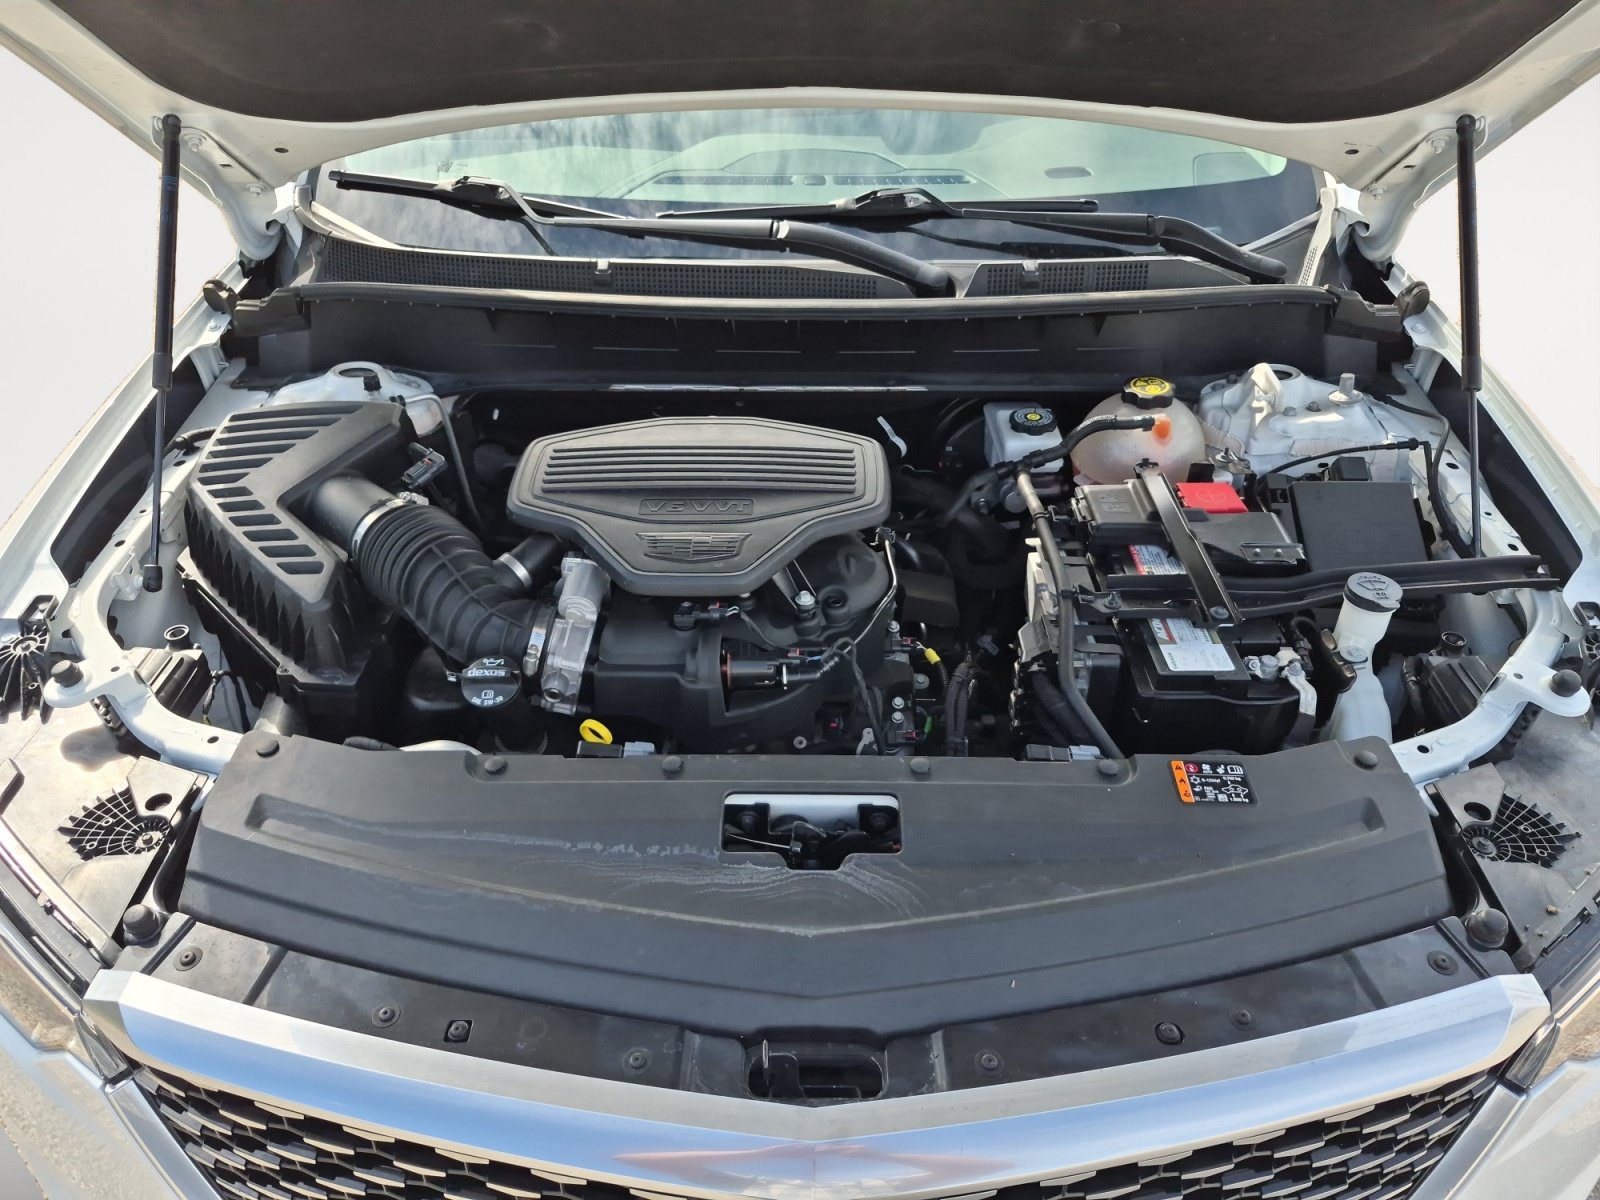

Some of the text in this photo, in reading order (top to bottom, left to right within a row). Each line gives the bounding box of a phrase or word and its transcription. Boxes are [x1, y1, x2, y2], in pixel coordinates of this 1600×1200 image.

[645, 501, 751, 513] V6 VVT
[467, 667, 506, 677] dexos
